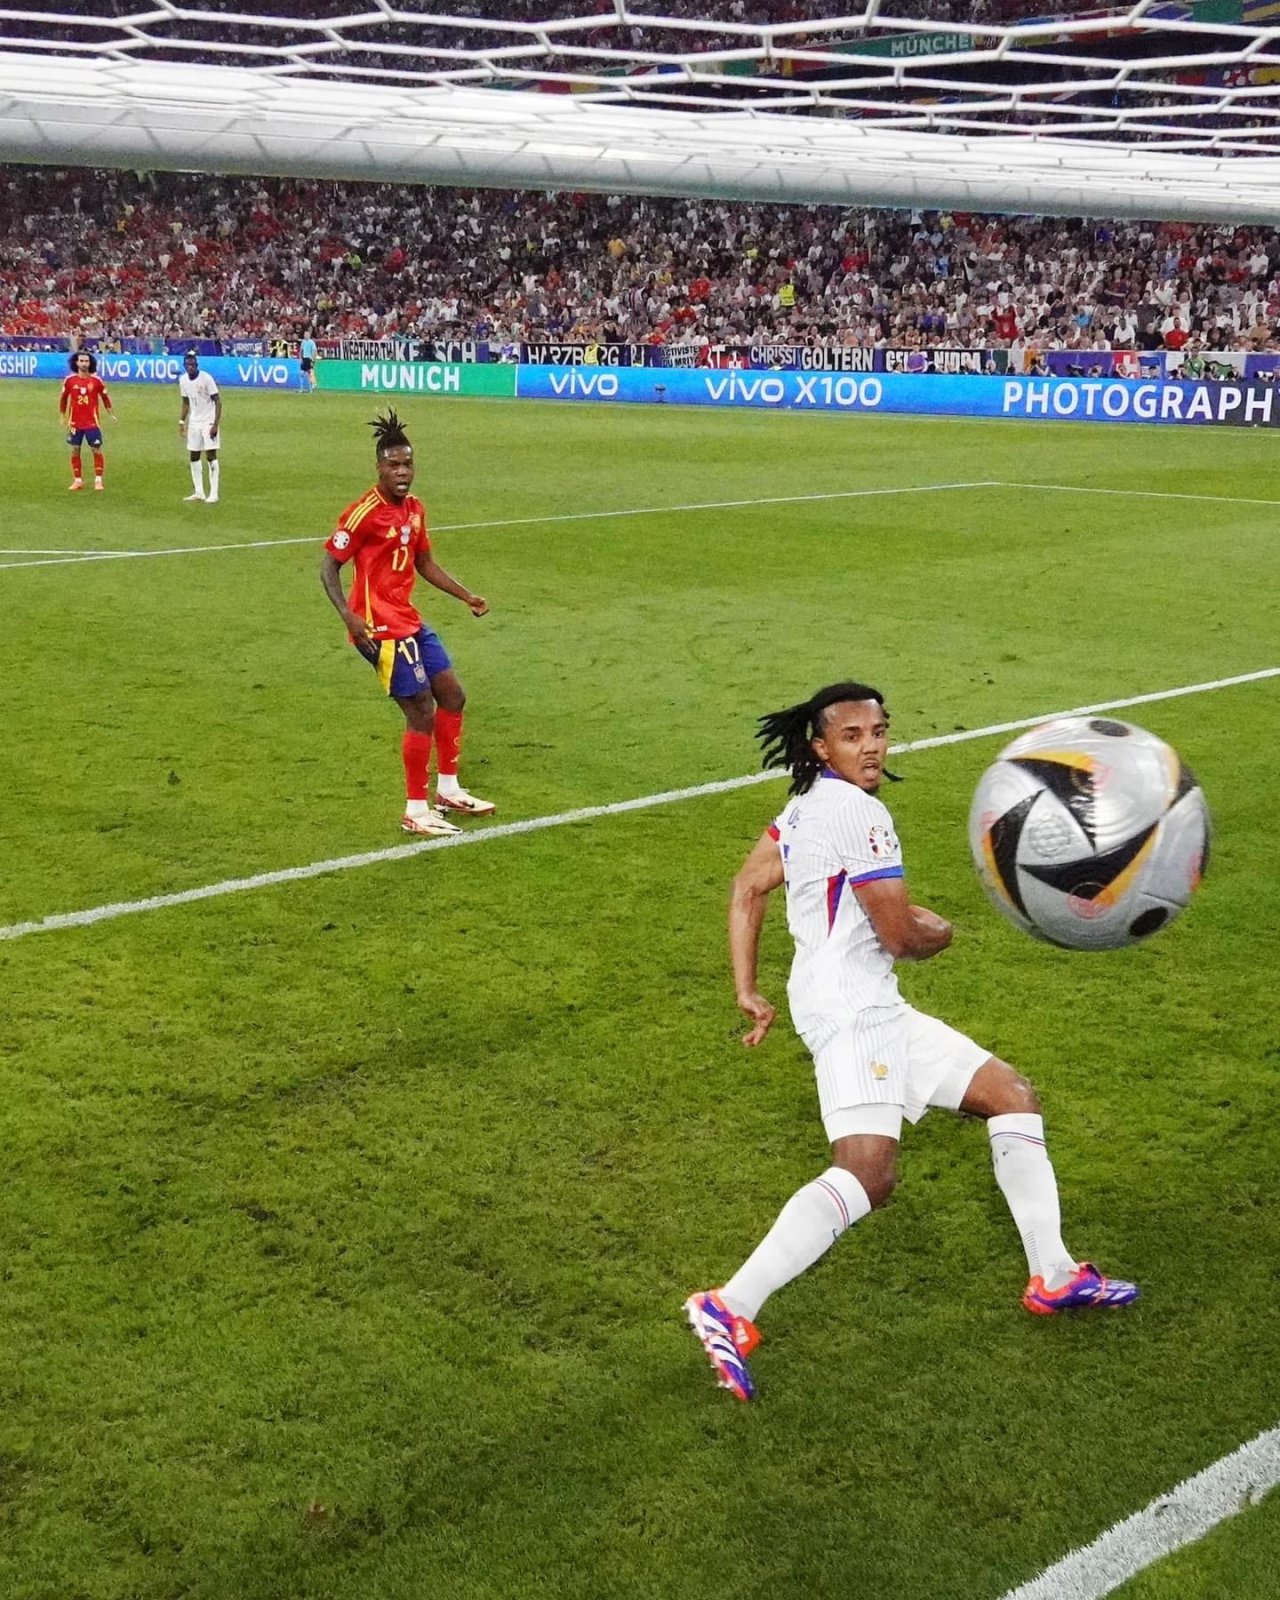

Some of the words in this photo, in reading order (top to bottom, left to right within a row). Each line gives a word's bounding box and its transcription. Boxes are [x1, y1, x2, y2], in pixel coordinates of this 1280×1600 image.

[238, 360, 289, 383] vivo
[802, 347, 873, 371] GOLTERN
[361, 364, 460, 391] MUNICH
[548, 367, 619, 396] vivo
[705, 371, 785, 403] vivo
[795, 376, 883, 407] X100
[77, 395, 89, 405] 24
[392, 546, 409, 572] 17
[397, 636, 420, 665] 17
